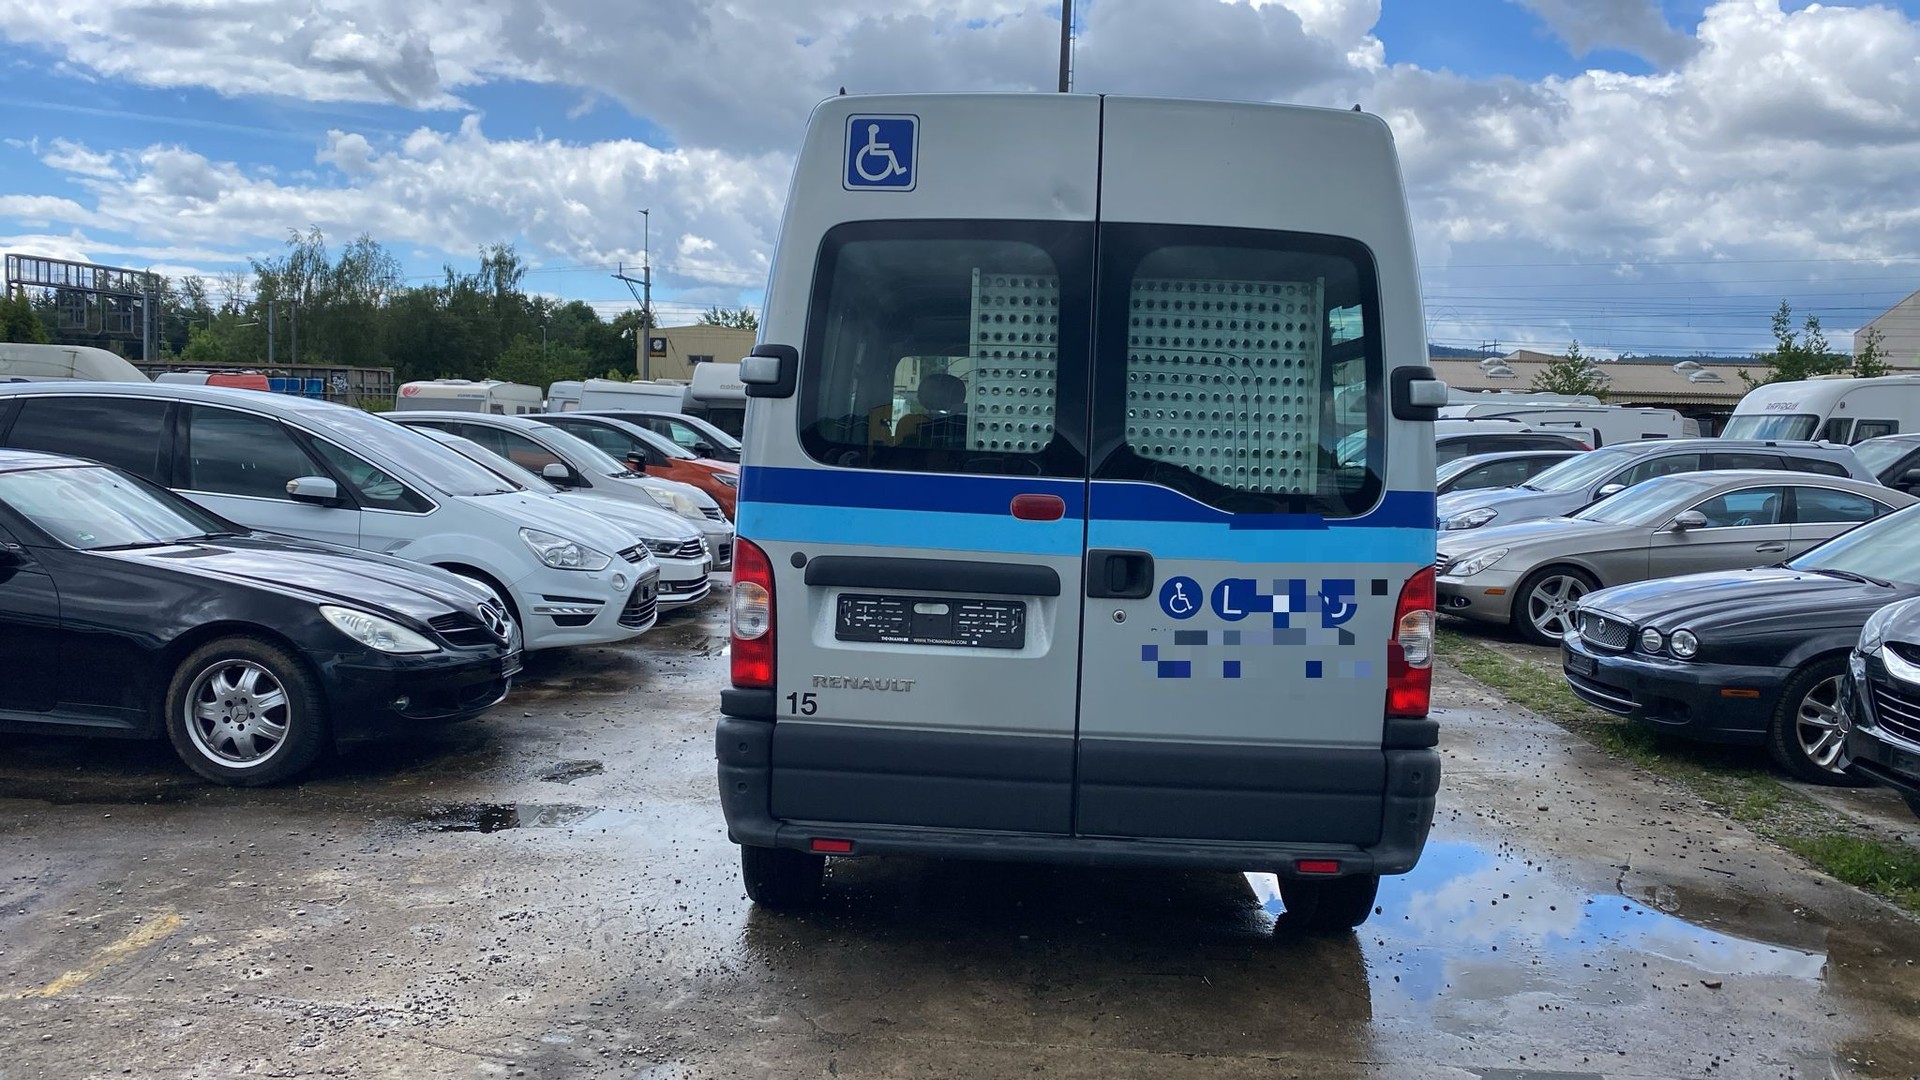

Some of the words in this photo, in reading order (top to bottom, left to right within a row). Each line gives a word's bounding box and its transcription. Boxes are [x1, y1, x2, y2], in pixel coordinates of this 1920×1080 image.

[1223, 585, 1242, 614] L
[812, 674, 916, 693] RENAULT
[786, 691, 818, 716] 15
